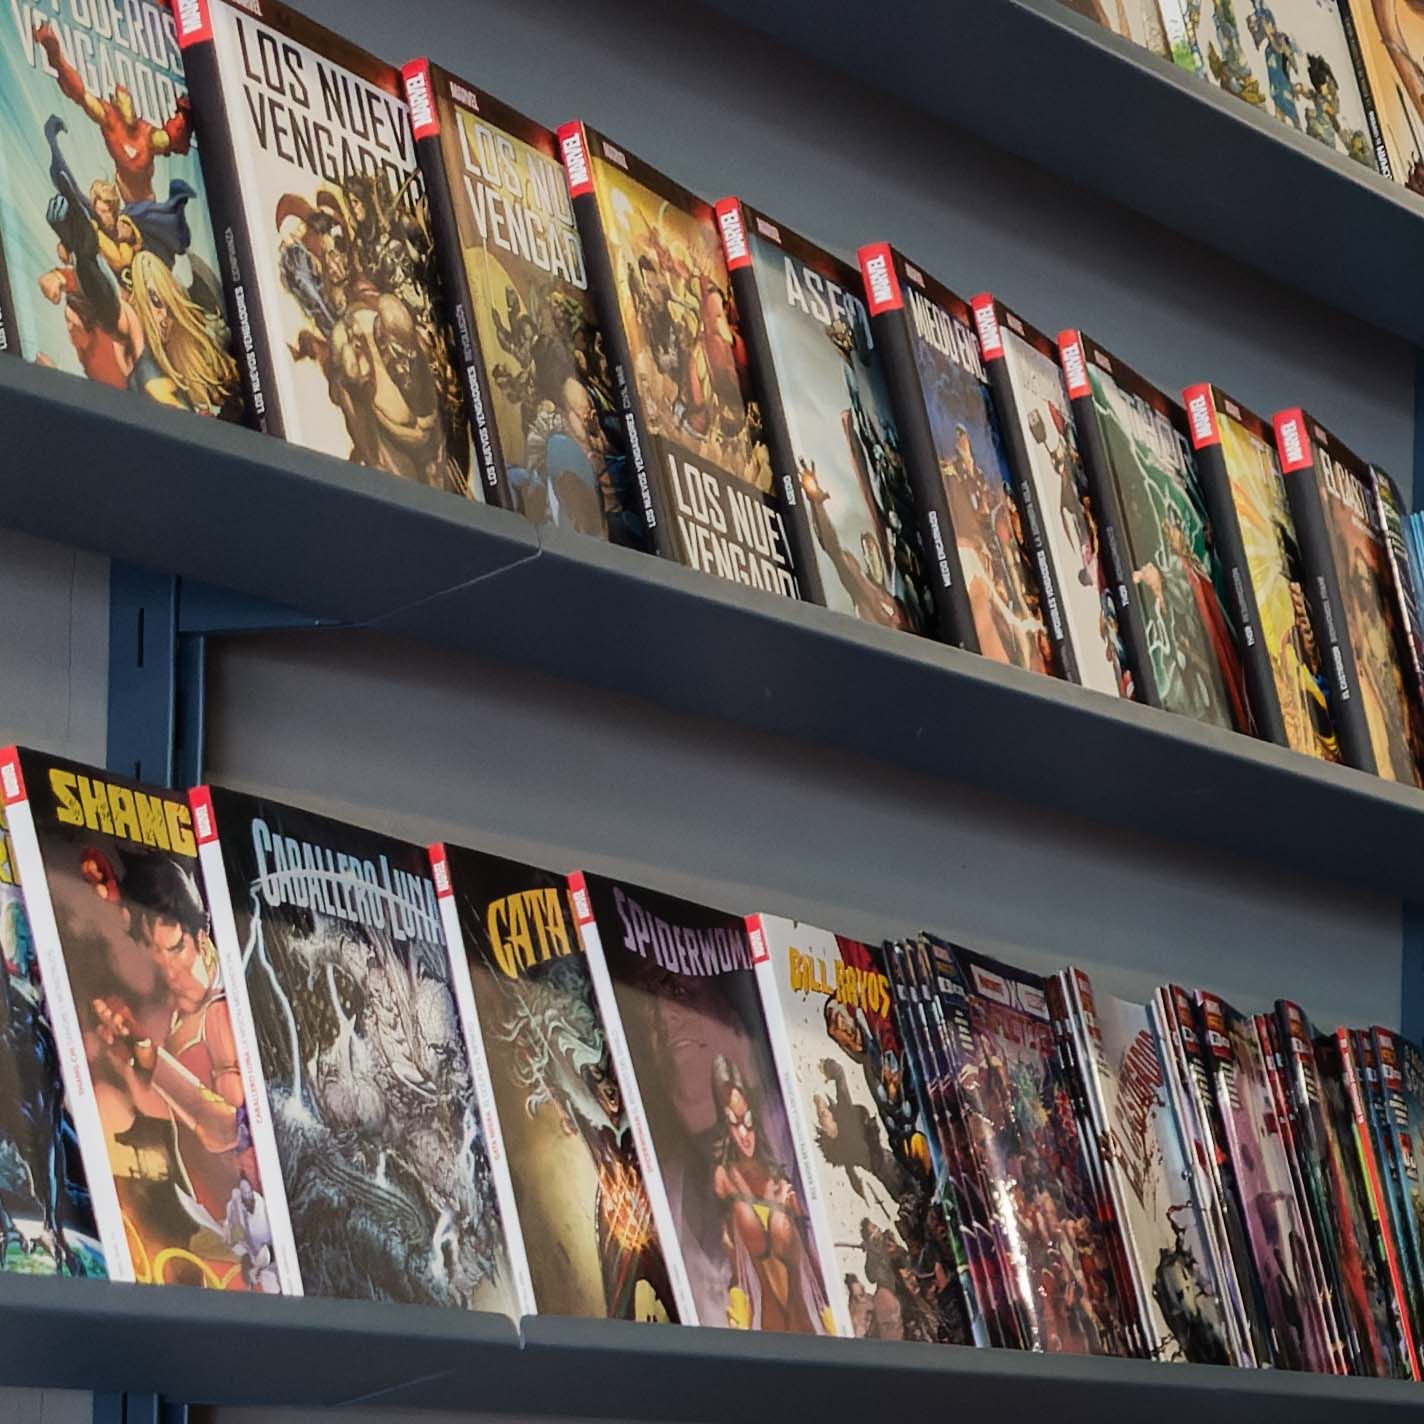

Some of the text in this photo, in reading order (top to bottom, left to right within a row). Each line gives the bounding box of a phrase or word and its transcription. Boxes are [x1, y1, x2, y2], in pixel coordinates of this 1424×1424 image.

[235, 17, 309, 109] LOS
[405, 71, 433, 130] MARVEL
[455, 111, 523, 200] LOS
[560, 133, 592, 187] MARVEL
[719, 207, 750, 261] MARVEL
[867, 253, 895, 305] MARVEL
[232, 285, 255, 351] VENGADORES
[977, 303, 1002, 360] MARVEL
[245, 351, 262, 392] NUEVOS
[1062, 341, 1088, 391] MARVEL
[253, 392, 266, 413] LOS
[464, 364, 488, 427] VENGADORES
[1187, 391, 1215, 441] MARVEL
[478, 426, 496, 465] NUEVOS
[622, 412, 646, 472] VENGADORES
[1279, 418, 1305, 465] MARVEL
[486, 465, 499, 486] LOS
[635, 471, 654, 508] NUEVOS
[667, 453, 727, 535] LOS
[780, 474, 799, 506] ASEDIO
[644, 508, 657, 527] LOS
[938, 560, 953, 587] MIEDO
[48, 767, 199, 859] SHANG
[250, 817, 447, 946] CABALLERO LUNA
[486, 886, 573, 980] GATA
